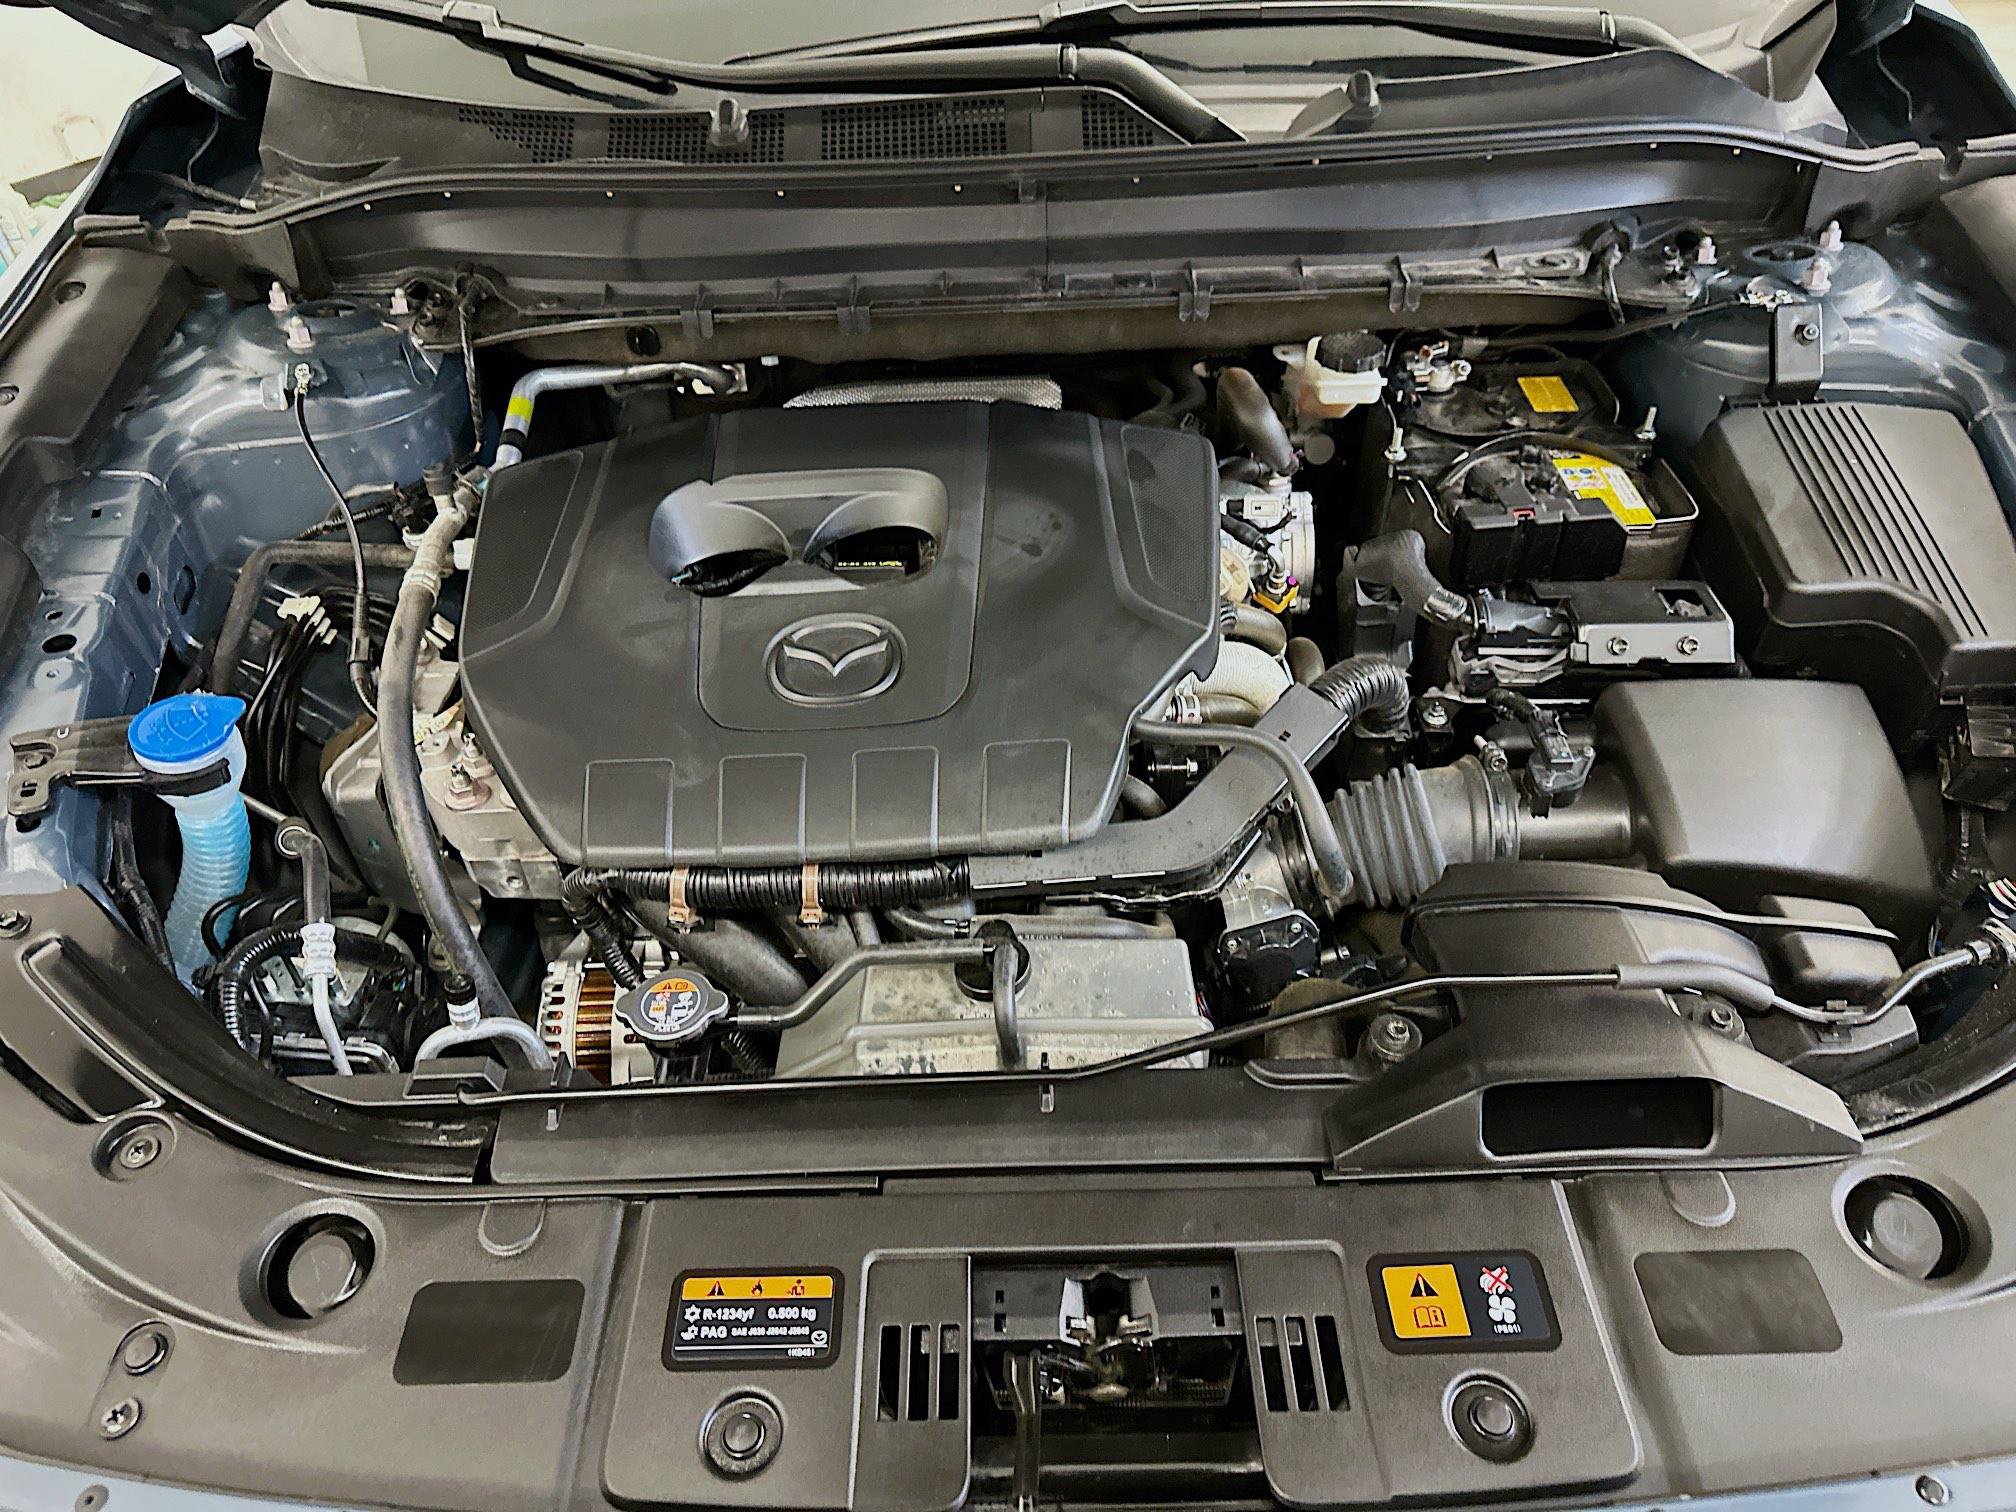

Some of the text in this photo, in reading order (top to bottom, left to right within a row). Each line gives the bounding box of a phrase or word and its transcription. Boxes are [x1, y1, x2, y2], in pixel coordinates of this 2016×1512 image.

[702, 1307, 755, 1322] R-1234yf
[801, 1306, 817, 1321] kg
[700, 1325, 728, 1339] PAG
